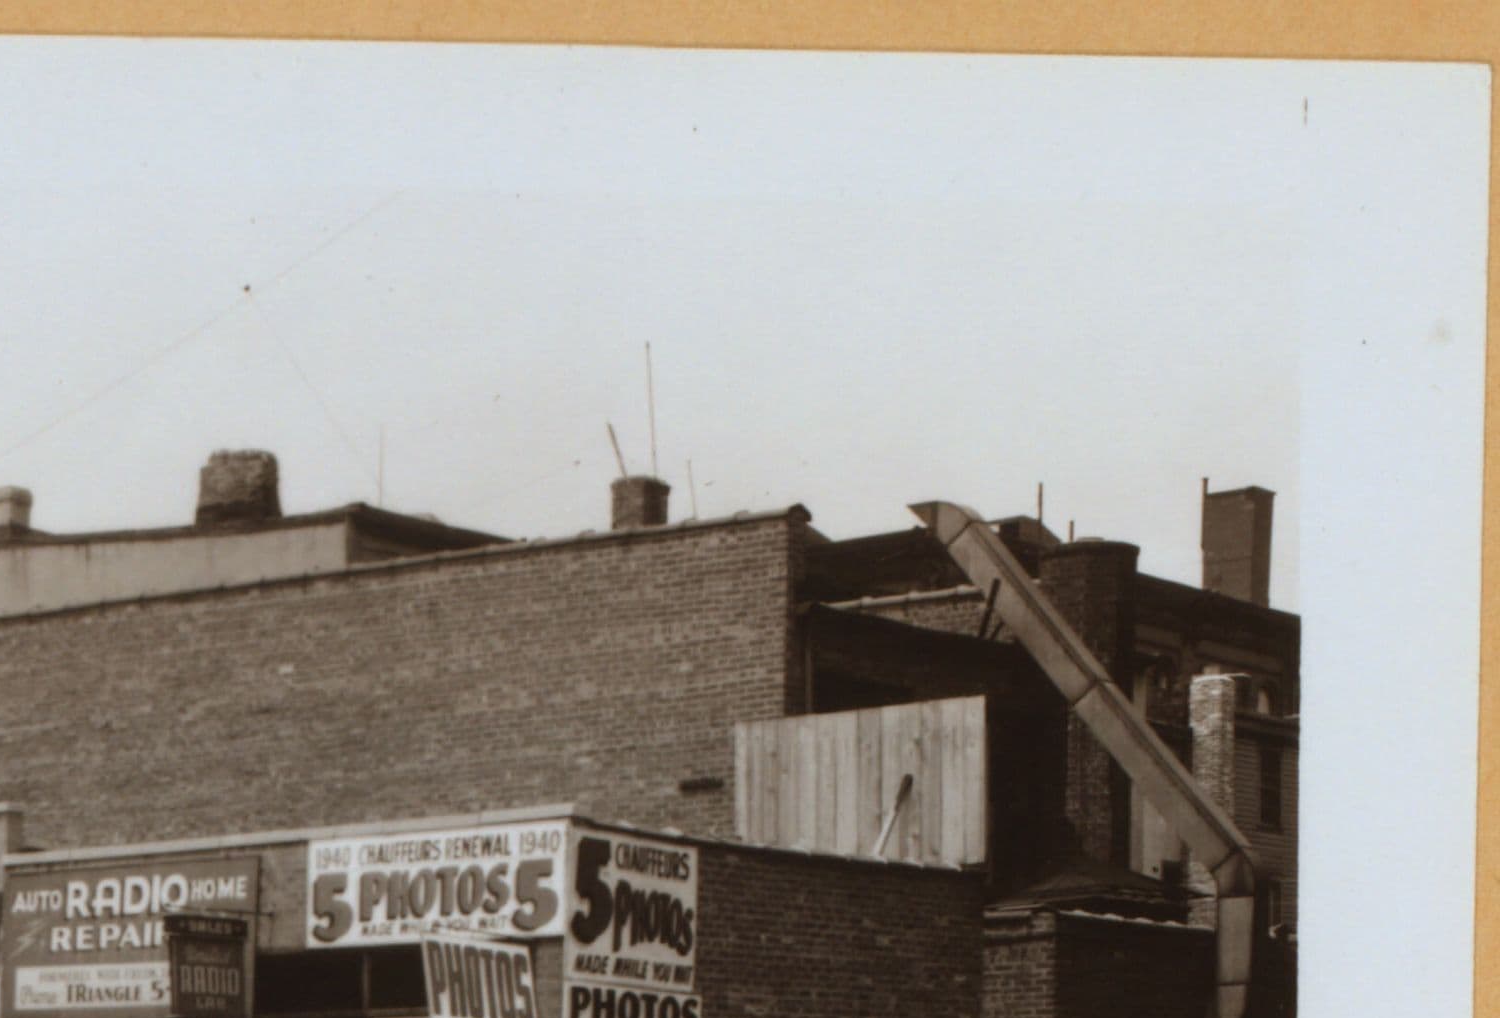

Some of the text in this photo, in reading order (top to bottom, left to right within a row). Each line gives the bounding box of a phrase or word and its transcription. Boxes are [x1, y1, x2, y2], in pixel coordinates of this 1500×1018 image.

[315, 845, 350, 870] 1940
[444, 833, 511, 860] RENEWAL
[519, 830, 560, 854] 1940
[11, 874, 248, 920] AUTO RADIO HOME
[312, 859, 559, 943] 5 PHOTOS 5
[570, 836, 612, 944] 5
[362, 923, 393, 936] MADE
[613, 880, 693, 957] PHOTOS
[180, 964, 240, 997] RADIO
[574, 954, 693, 984] MADE WHILE YOU WAIT
